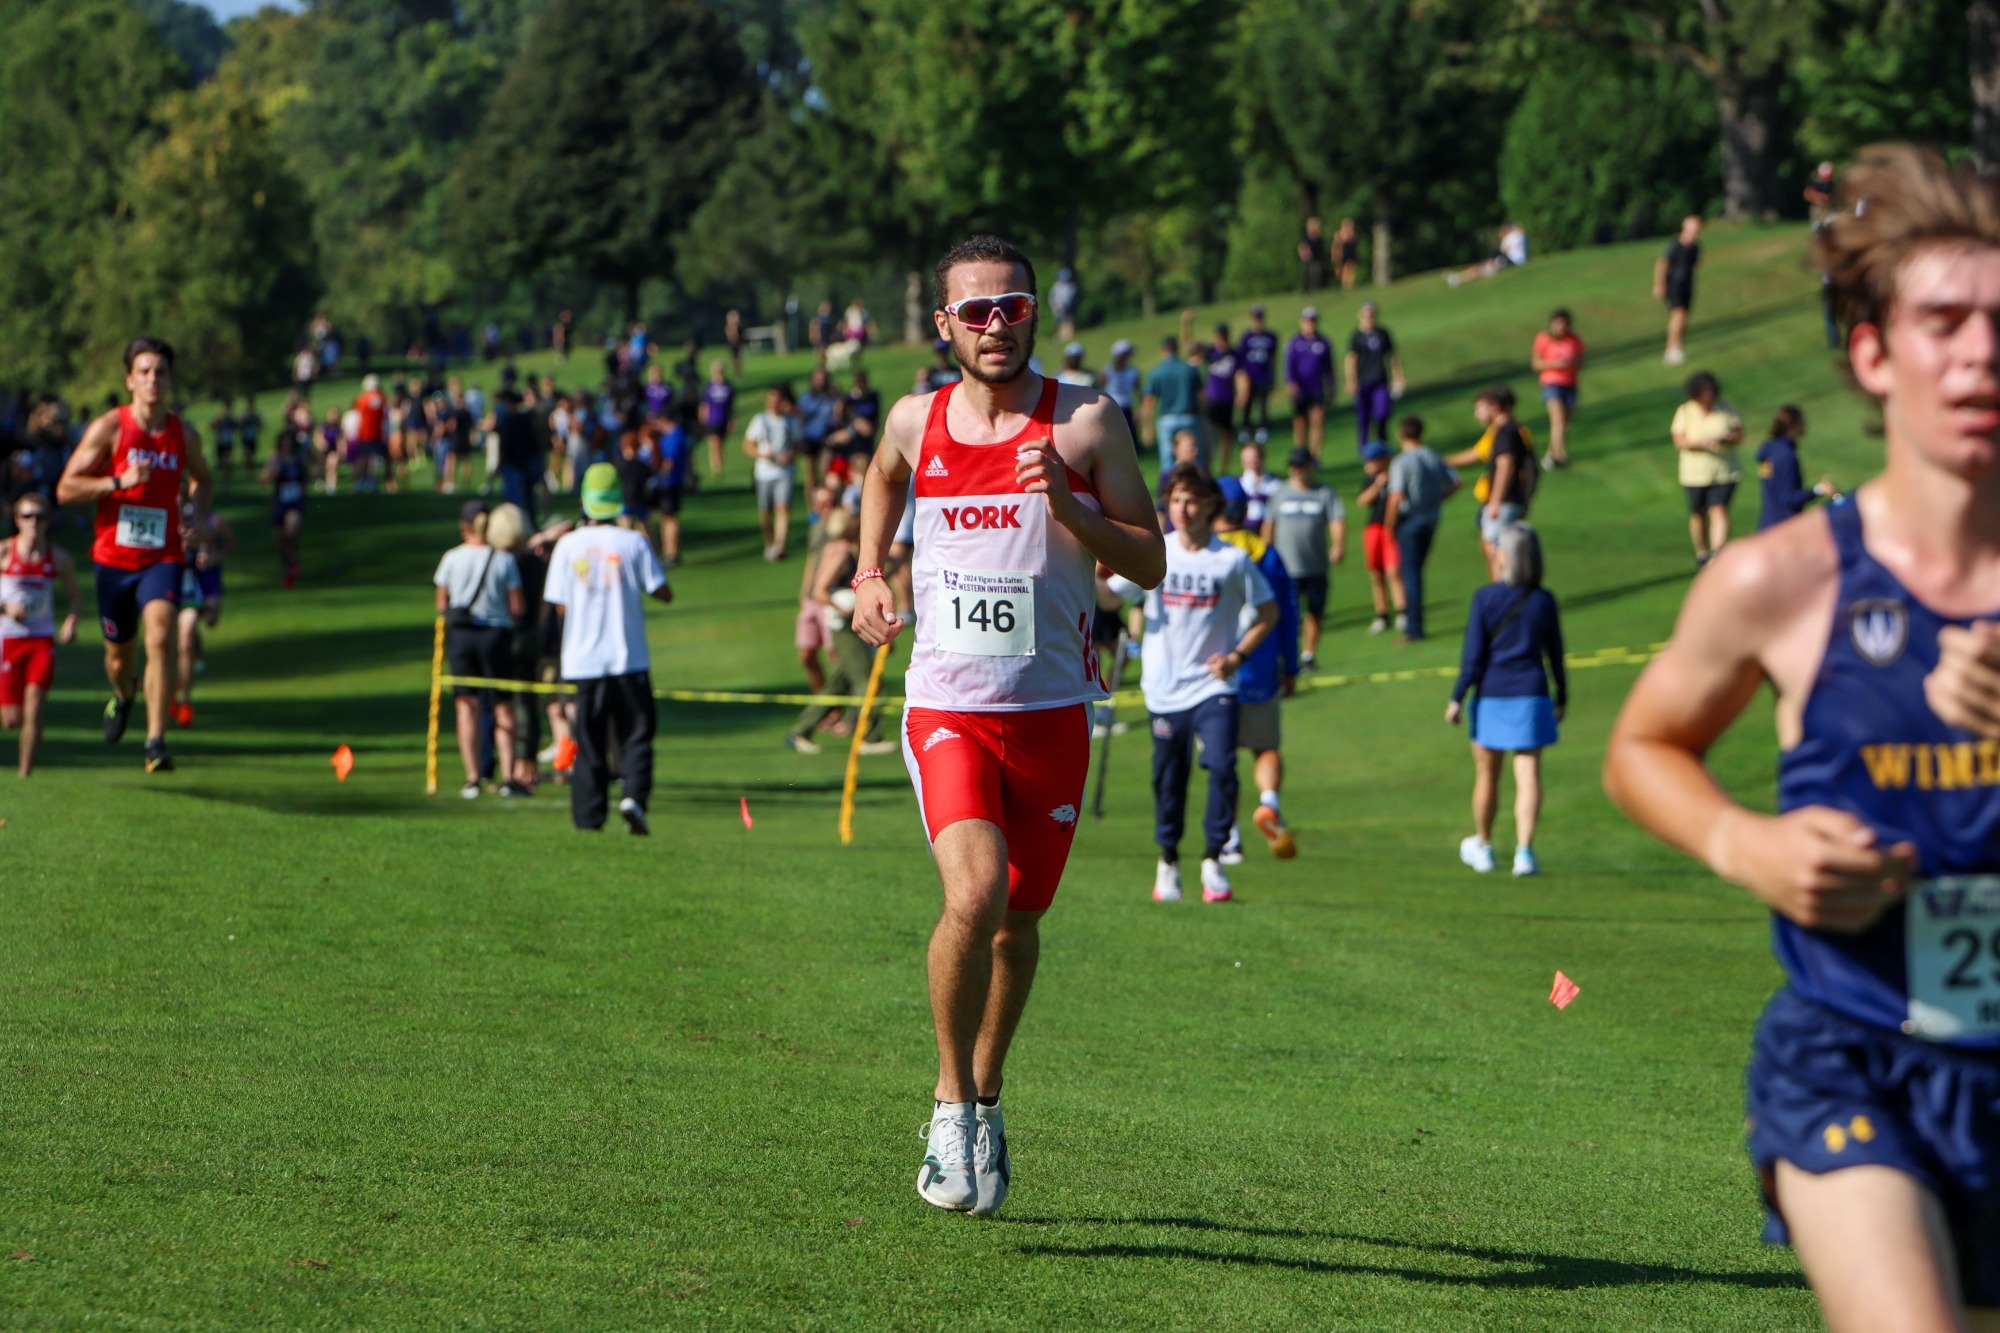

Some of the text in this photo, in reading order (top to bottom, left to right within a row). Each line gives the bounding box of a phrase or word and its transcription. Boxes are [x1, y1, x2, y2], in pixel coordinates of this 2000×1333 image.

[925, 468, 949, 477] adidas
[941, 504, 1022, 531] YORK
[963, 574, 1024, 585] 2024 Vigars & Salter
[958, 582, 1030, 594] WESTERN INVITATIONAL
[951, 596, 1016, 633] 146
